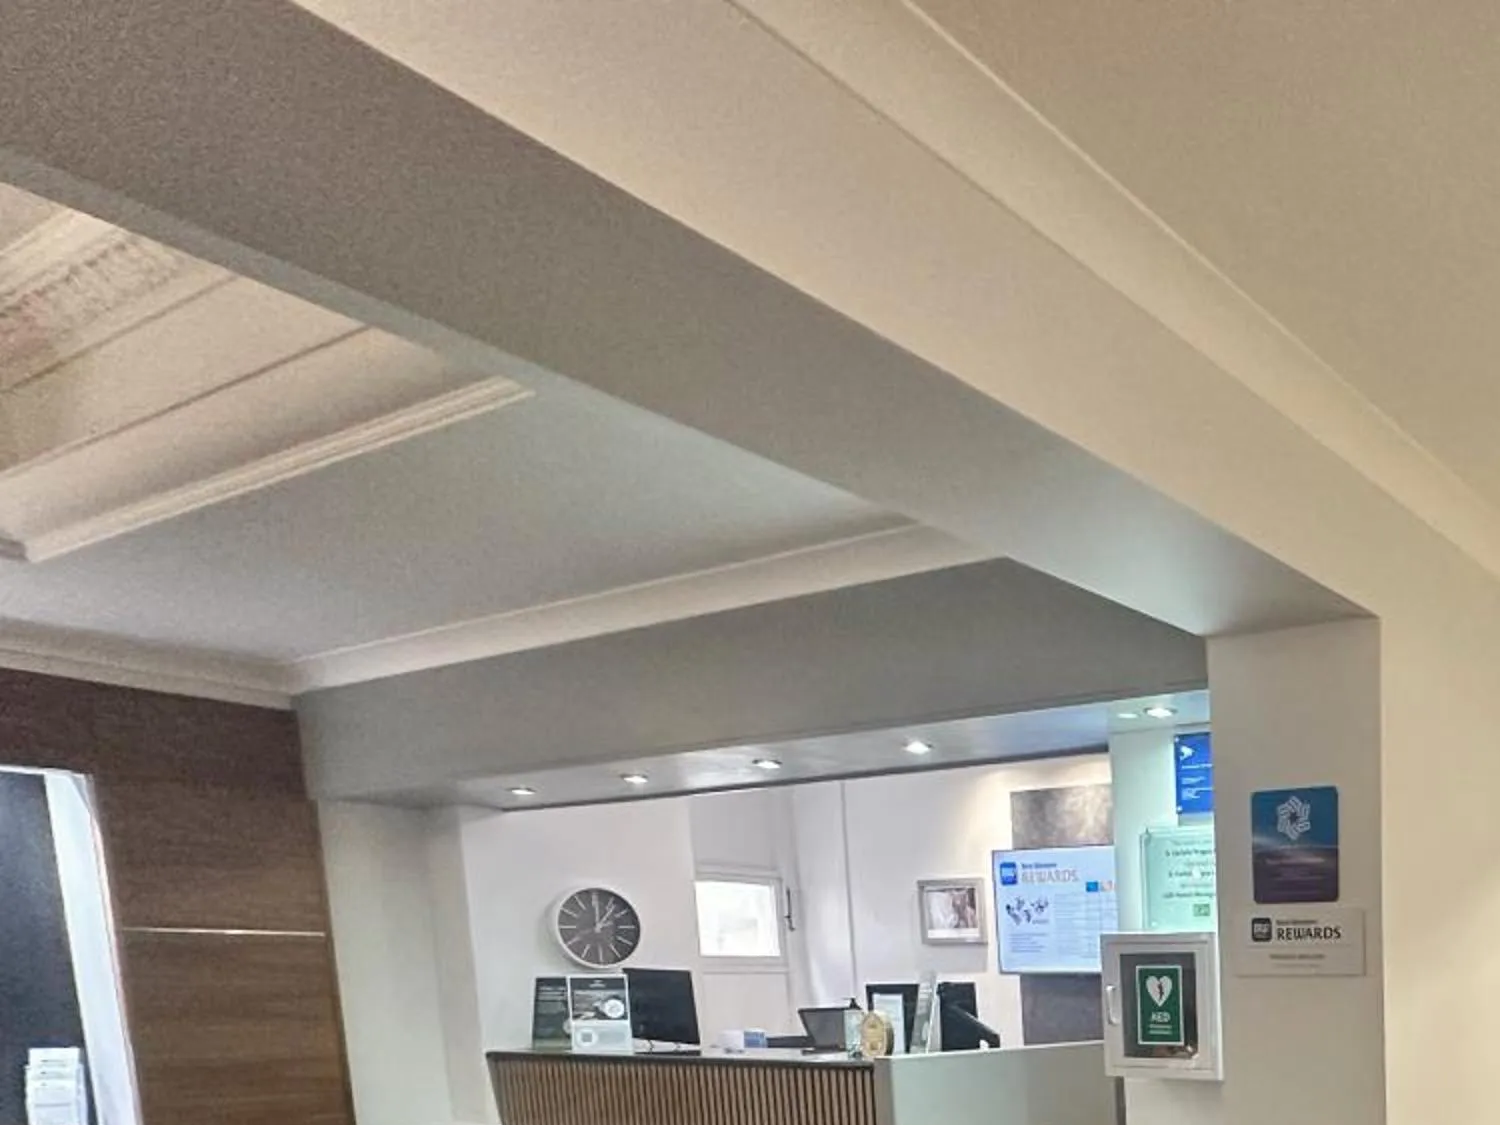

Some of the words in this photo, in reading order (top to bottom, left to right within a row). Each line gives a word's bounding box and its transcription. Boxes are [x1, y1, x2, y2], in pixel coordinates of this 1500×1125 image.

[1021, 869, 1080, 883] REWARDS
[1276, 926, 1342, 941] REWARDS
[1151, 1011, 1172, 1023] AED
